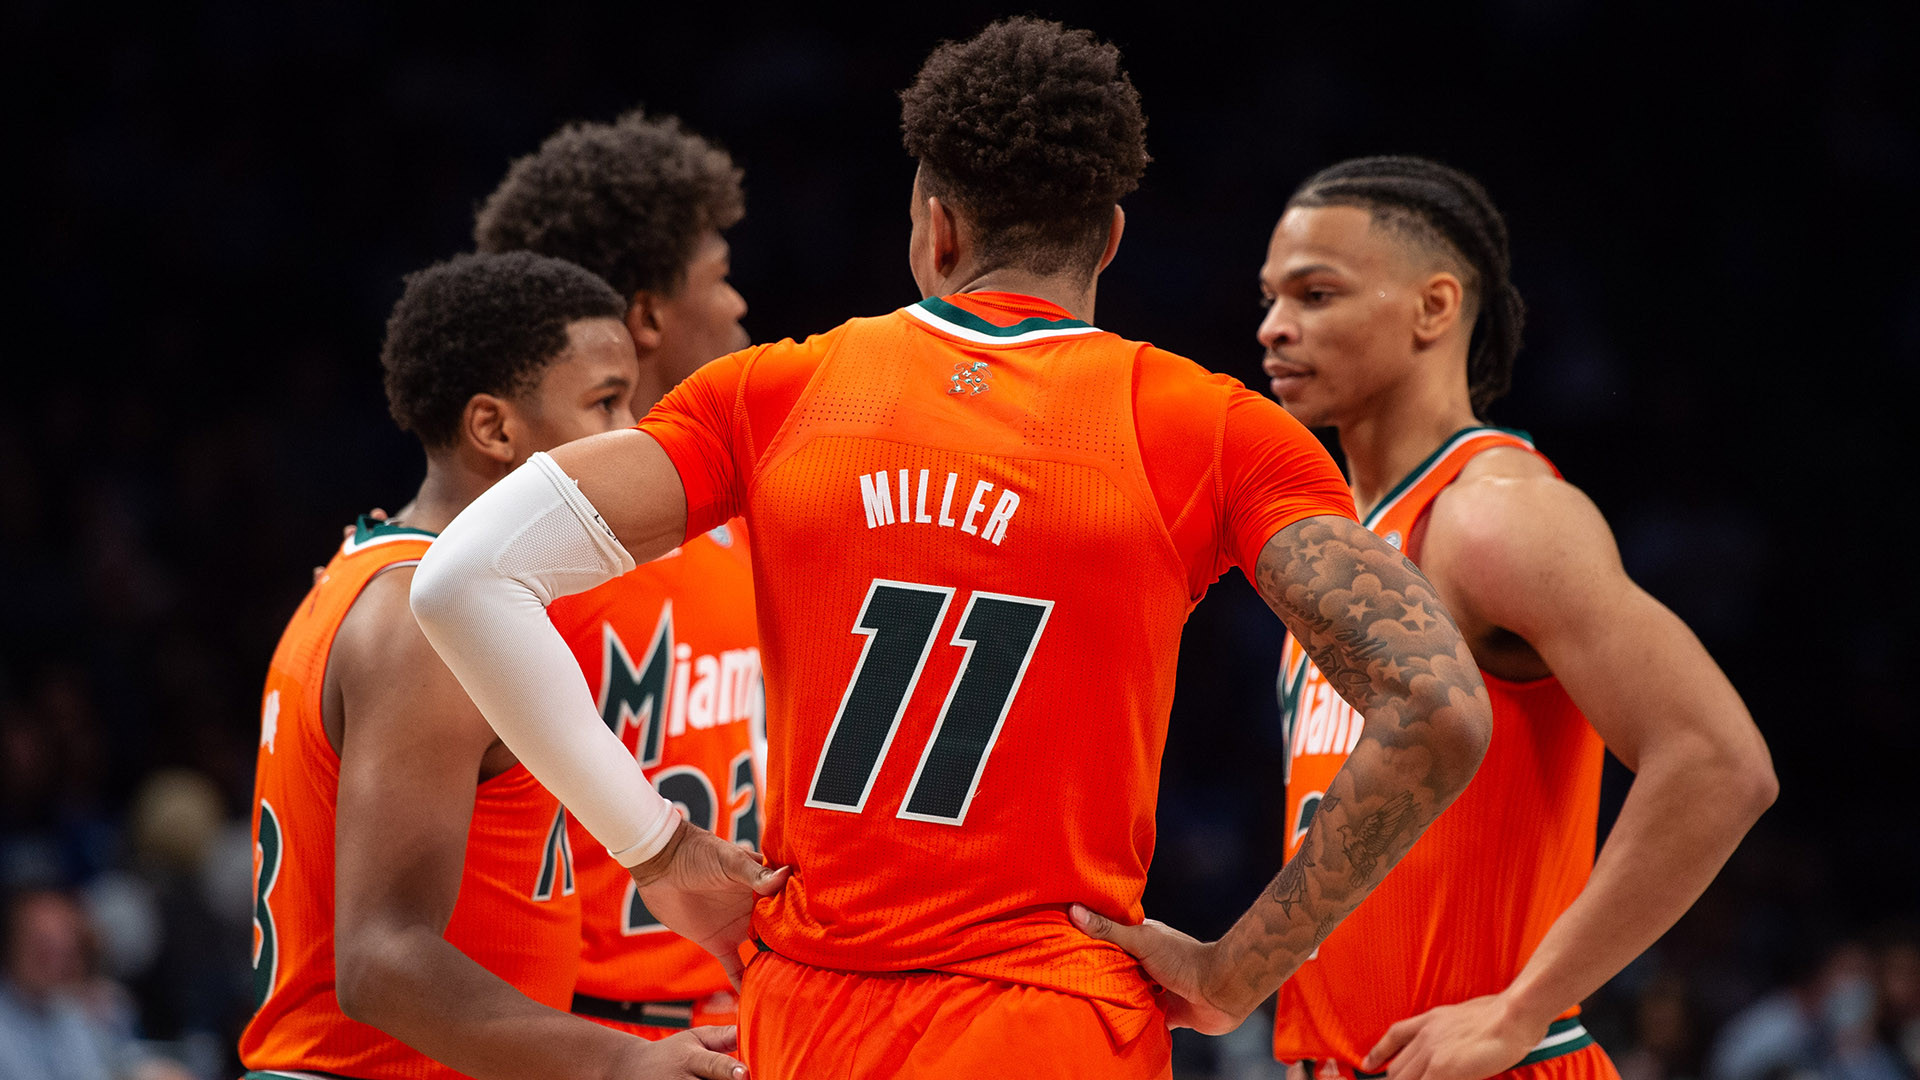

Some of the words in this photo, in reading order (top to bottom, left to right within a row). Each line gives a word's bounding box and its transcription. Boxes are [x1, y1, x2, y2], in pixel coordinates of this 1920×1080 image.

[860, 469, 1020, 545] MILLER
[600, 598, 761, 769] Miam
[804, 578, 1055, 826] 11
[1276, 630, 1364, 786] Miam
